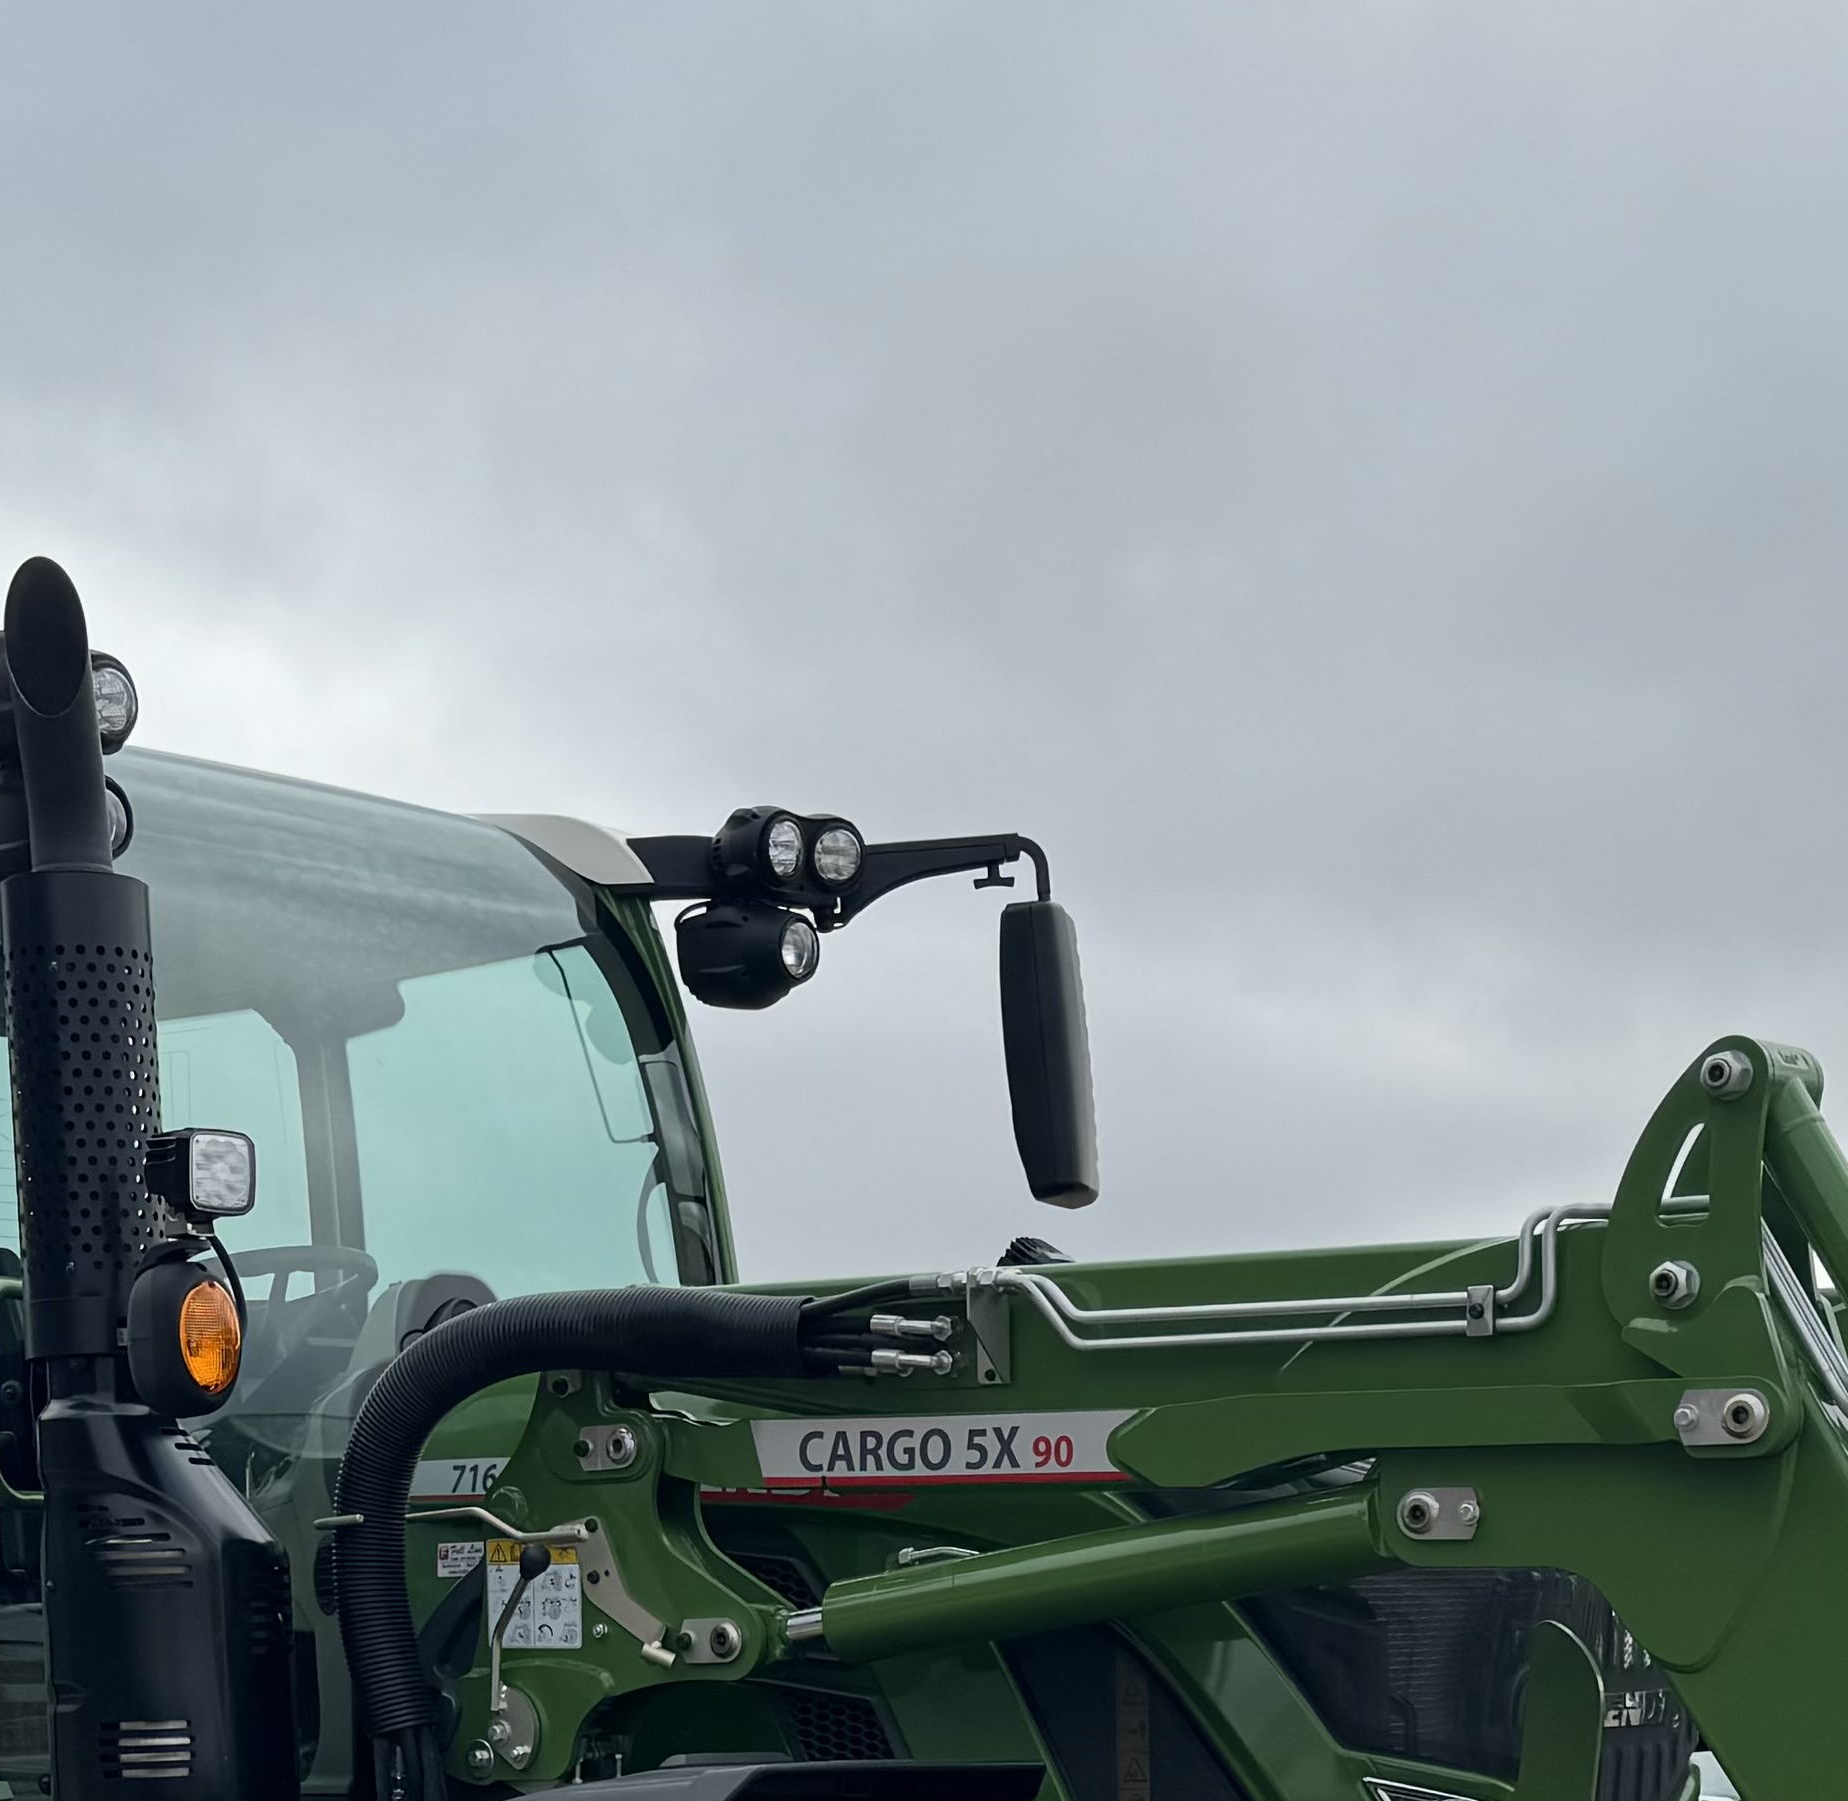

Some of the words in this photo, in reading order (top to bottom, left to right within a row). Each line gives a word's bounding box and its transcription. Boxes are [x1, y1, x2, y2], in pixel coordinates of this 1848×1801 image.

[799, 1428, 951, 1473] CARGO
[965, 1426, 1021, 1470] 5X
[1032, 1435, 1073, 1468] 90
[452, 1464, 497, 1493] 716
